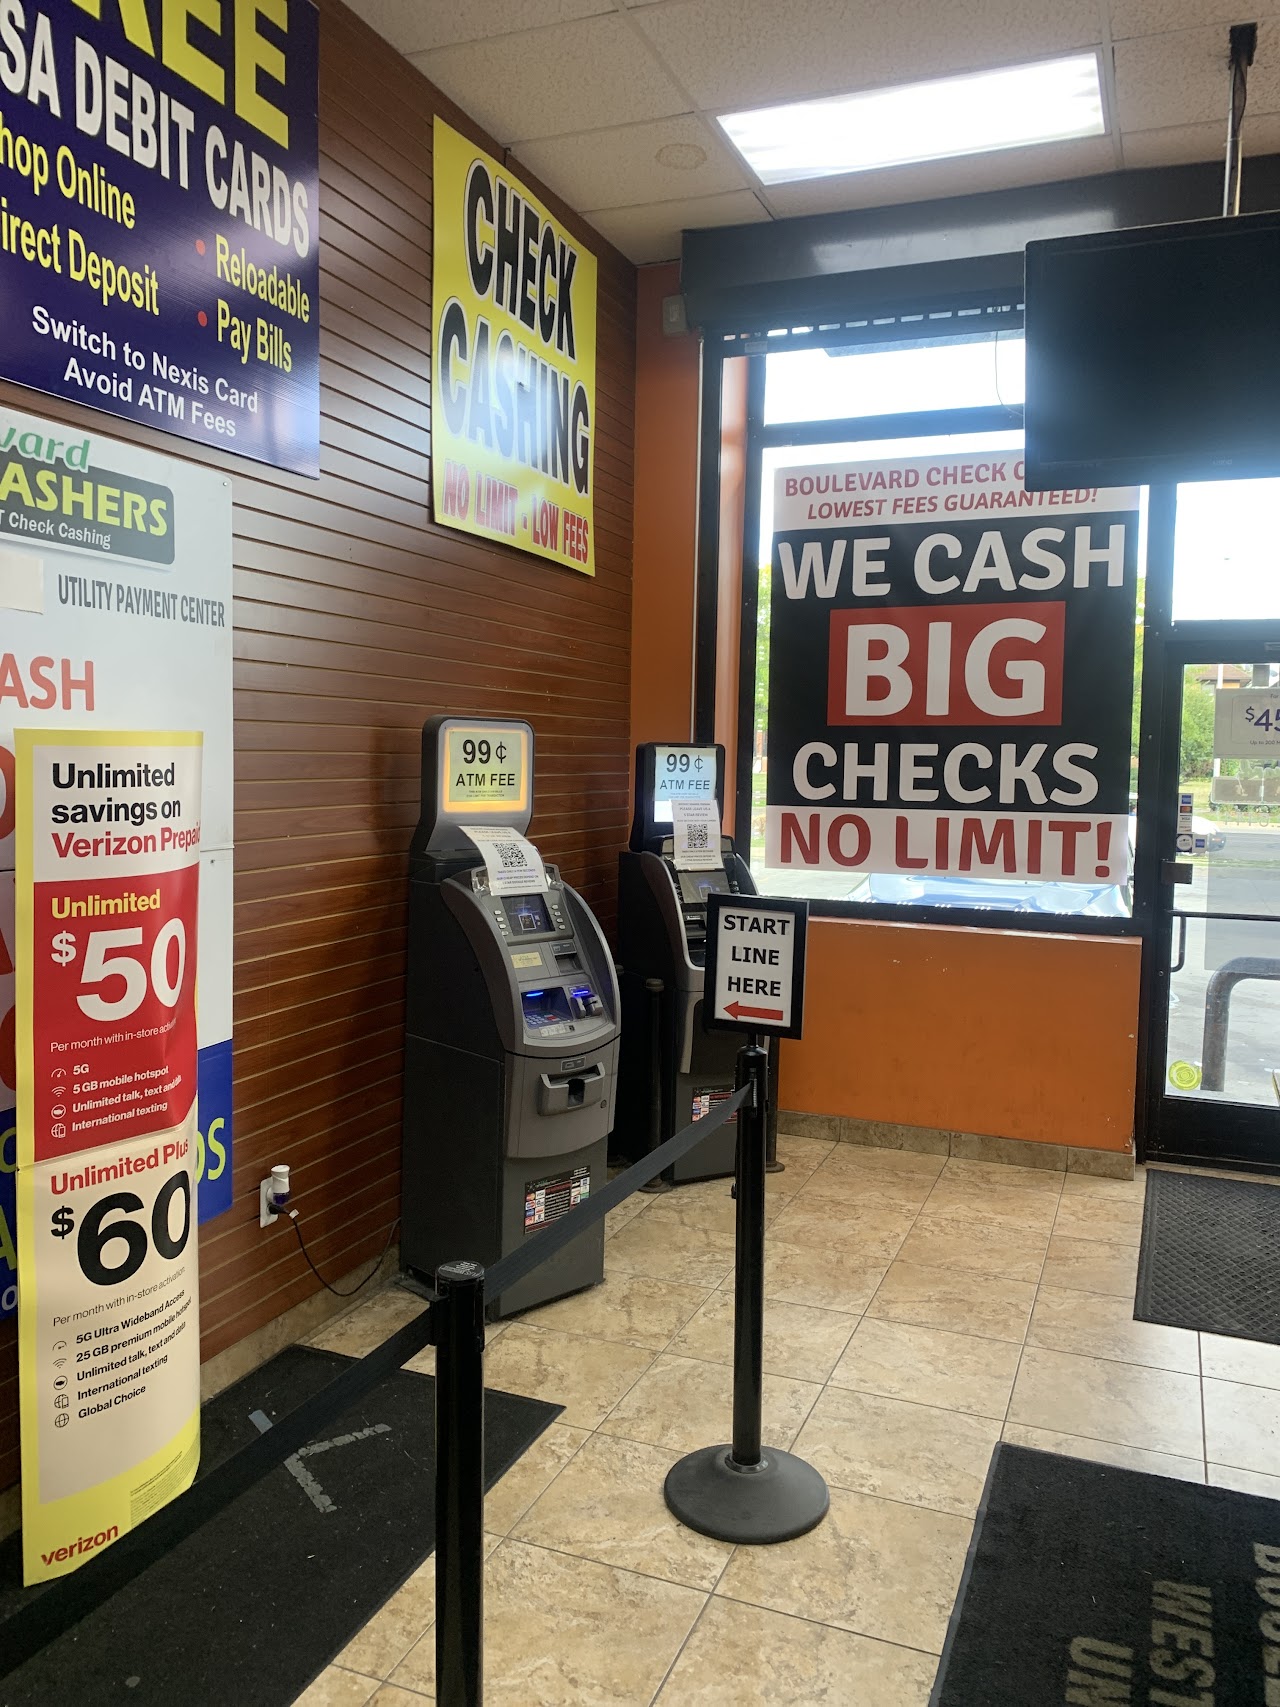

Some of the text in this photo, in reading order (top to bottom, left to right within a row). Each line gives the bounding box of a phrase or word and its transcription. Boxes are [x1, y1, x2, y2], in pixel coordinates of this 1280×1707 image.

[71, 0, 289, 150] EE
[0, 0, 309, 258] SA DEBIT CARDS
[56, 145, 136, 229] Online
[2, 196, 159, 316] irect Deposit
[216, 233, 309, 323] Reloadable
[465, 159, 577, 364] CHECK
[32, 306, 258, 413] Switch to Nexis Card
[217, 301, 292, 372] Pay Bills
[64, 357, 236, 437] Avoid ATM Fees
[439, 297, 589, 495] CASHING
[785, 468, 919, 497] BOULEVARD
[926, 462, 1007, 486] CHECK
[807, 488, 1098, 520] LOWEST FEES GUARANTEED!
[9, 511, 54, 536] Check
[58, 523, 111, 549] Cashing
[442, 459, 469, 520] NO
[476, 473, 517, 536] LIMIT
[531, 494, 558, 549] LOW
[563, 511, 588, 564] FEES
[778, 524, 1126, 599] WE CASH
[58, 574, 225, 627] UTILITY PAYMENT CENTER
[845, 618, 1047, 717] BIG
[52, 762, 175, 789] Unlimited
[456, 774, 515, 787] ATM FEE
[660, 780, 710, 790] ATM FEE
[792, 741, 1099, 807] CHECKS
[51, 797, 181, 826] savings on
[51, 829, 156, 858] Verizon
[780, 812, 1113, 878] NO LIMIT!
[51, 889, 161, 919] Unlimited
[723, 914, 790, 935] START
[51, 917, 186, 1022] $50
[732, 946, 779, 966] LINE
[727, 976, 781, 997] HERE
[50, 1026, 158, 1053] Per month with in-store
[73, 1064, 89, 1075] 5G
[73, 1084, 80, 1094] 5
[82, 1081, 98, 1092] GB
[99, 1074, 133, 1089] mobile
[72, 1094, 121, 1113] Unlimited
[123, 1090, 143, 1102] talk,
[144, 1085, 162, 1097] text
[72, 1102, 168, 1131] International texting
[51, 1147, 159, 1196] Unlimited
[51, 1170, 191, 1286] $60
[53, 1313, 71, 1327] Per
[73, 1304, 104, 1320] month
[106, 1297, 125, 1310] with
[126, 1283, 158, 1303] in-store
[76, 1290, 185, 1344] 5G Ultra Wideband Access
[76, 1350, 91, 1363] 25
[93, 1345, 109, 1357] GB
[111, 1329, 152, 1354] premium
[153, 1313, 176, 1335] mobile
[77, 1357, 127, 1381] Unlimited
[128, 1349, 148, 1365] talk,
[148, 1339, 164, 1354] text
[164, 1329, 176, 1346] and
[77, 1354, 168, 1400] International texting
[78, 1385, 146, 1419] Global Choice
[41, 1525, 119, 1567] verizon
